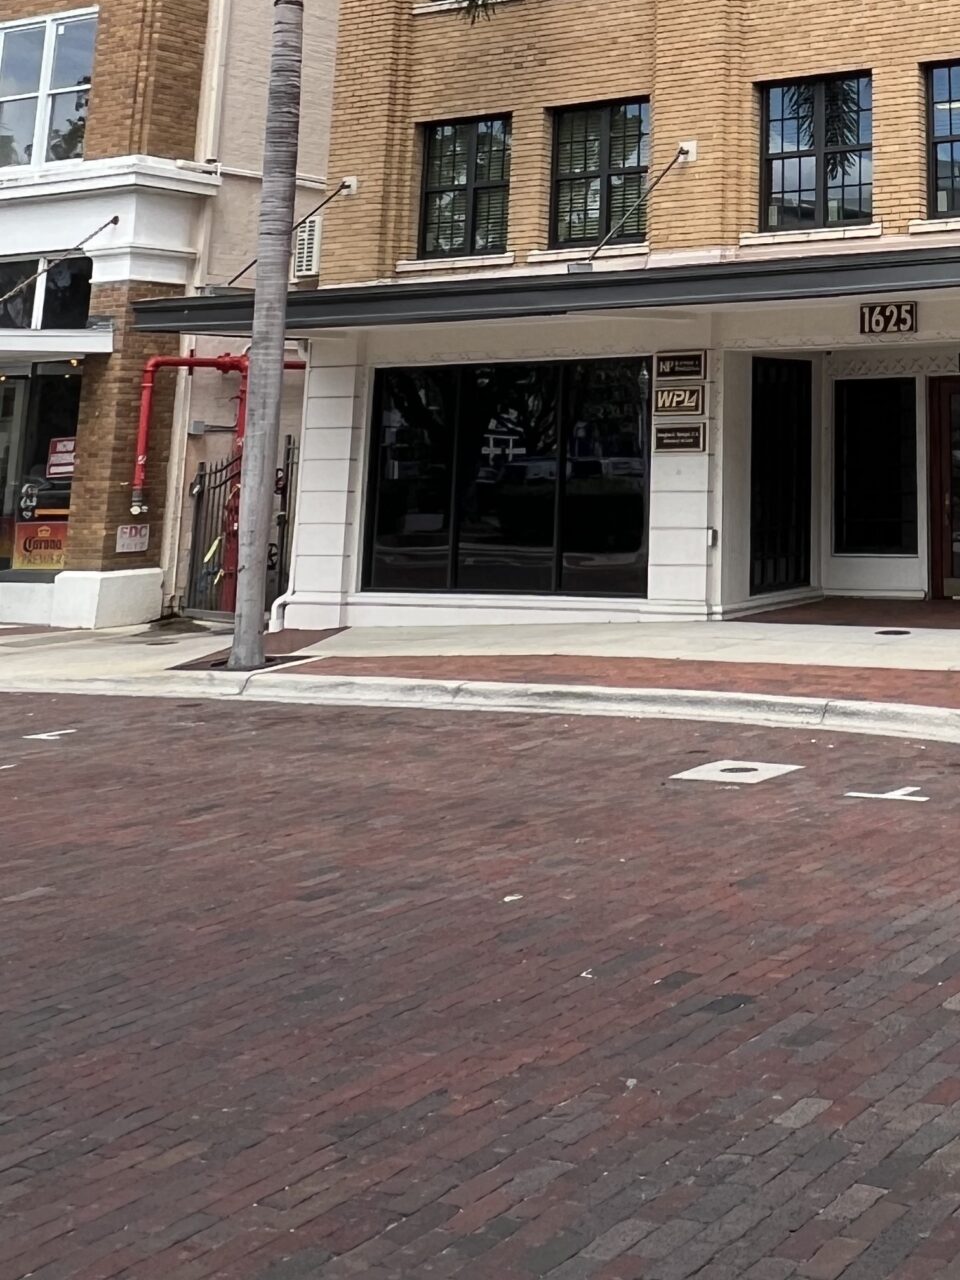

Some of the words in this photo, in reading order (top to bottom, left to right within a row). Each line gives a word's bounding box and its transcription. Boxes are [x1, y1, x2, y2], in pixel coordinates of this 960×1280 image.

[862, 304, 912, 333] 1625
[120, 525, 148, 538] FDC
[23, 536, 62, 552] Corona
